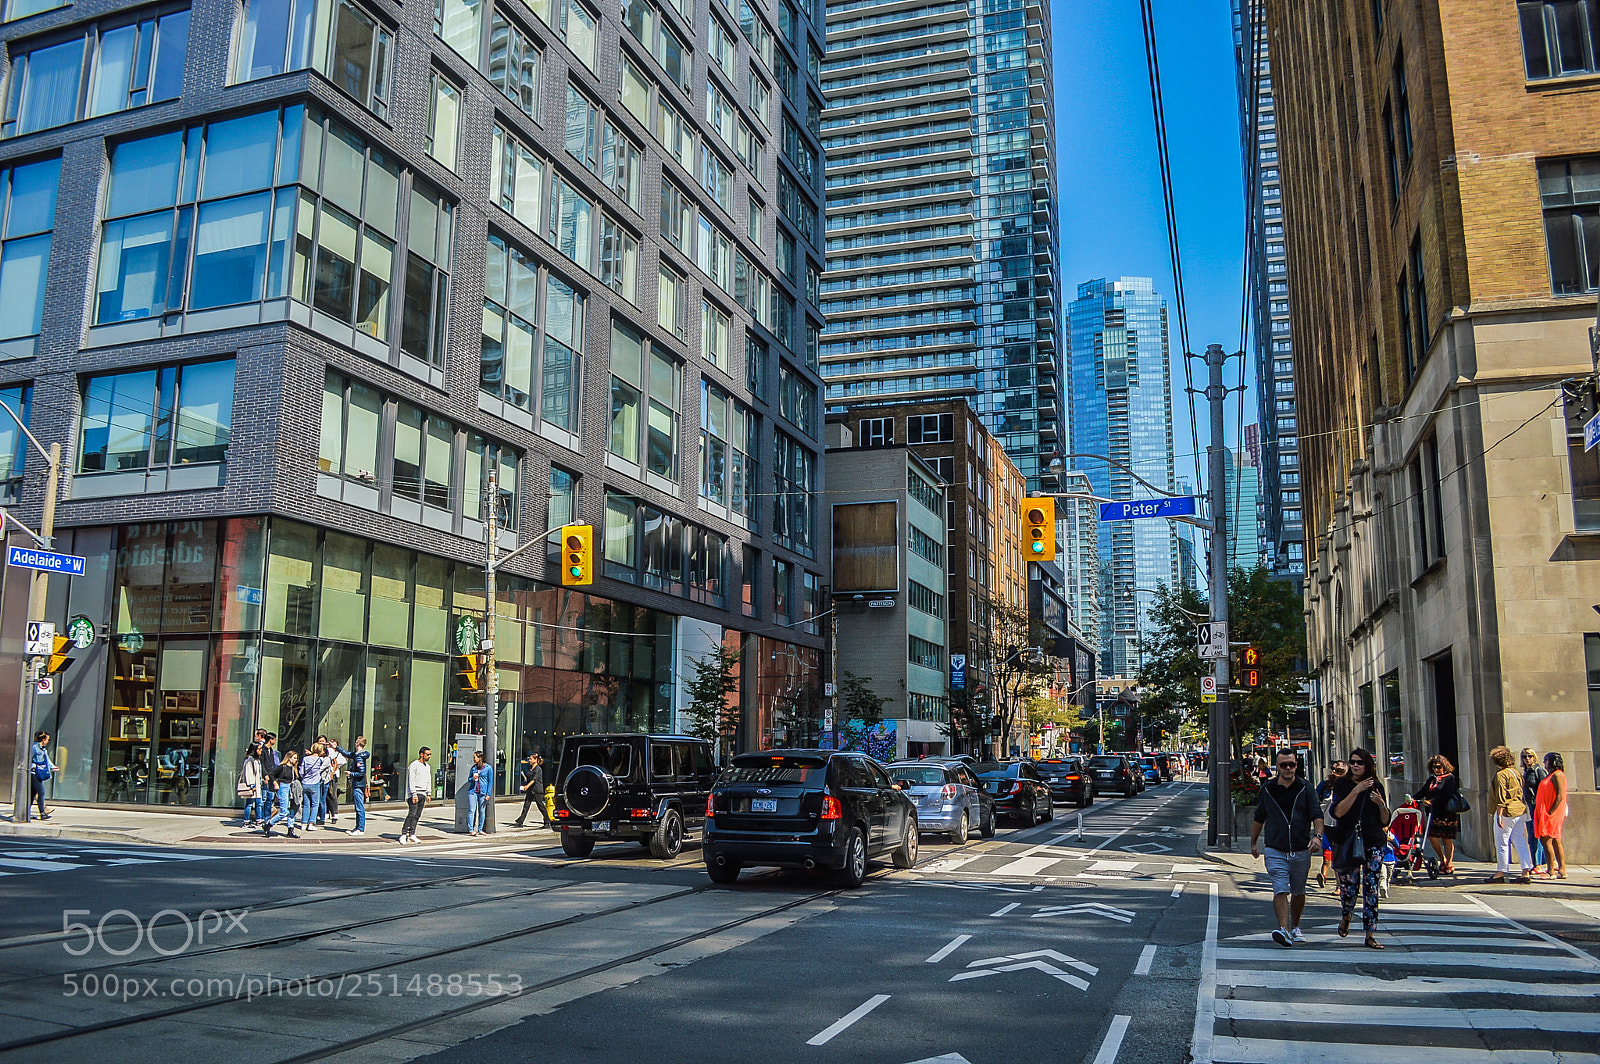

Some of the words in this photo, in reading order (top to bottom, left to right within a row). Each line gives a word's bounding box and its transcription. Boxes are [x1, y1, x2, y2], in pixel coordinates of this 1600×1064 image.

[1123, 503, 1159, 516] Peter
[1164, 500, 1171, 508] St
[12, 550, 62, 569] Adelaide
[65, 557, 72, 565] St
[73, 559, 82, 571] W
[1250, 671, 1257, 686] 8
